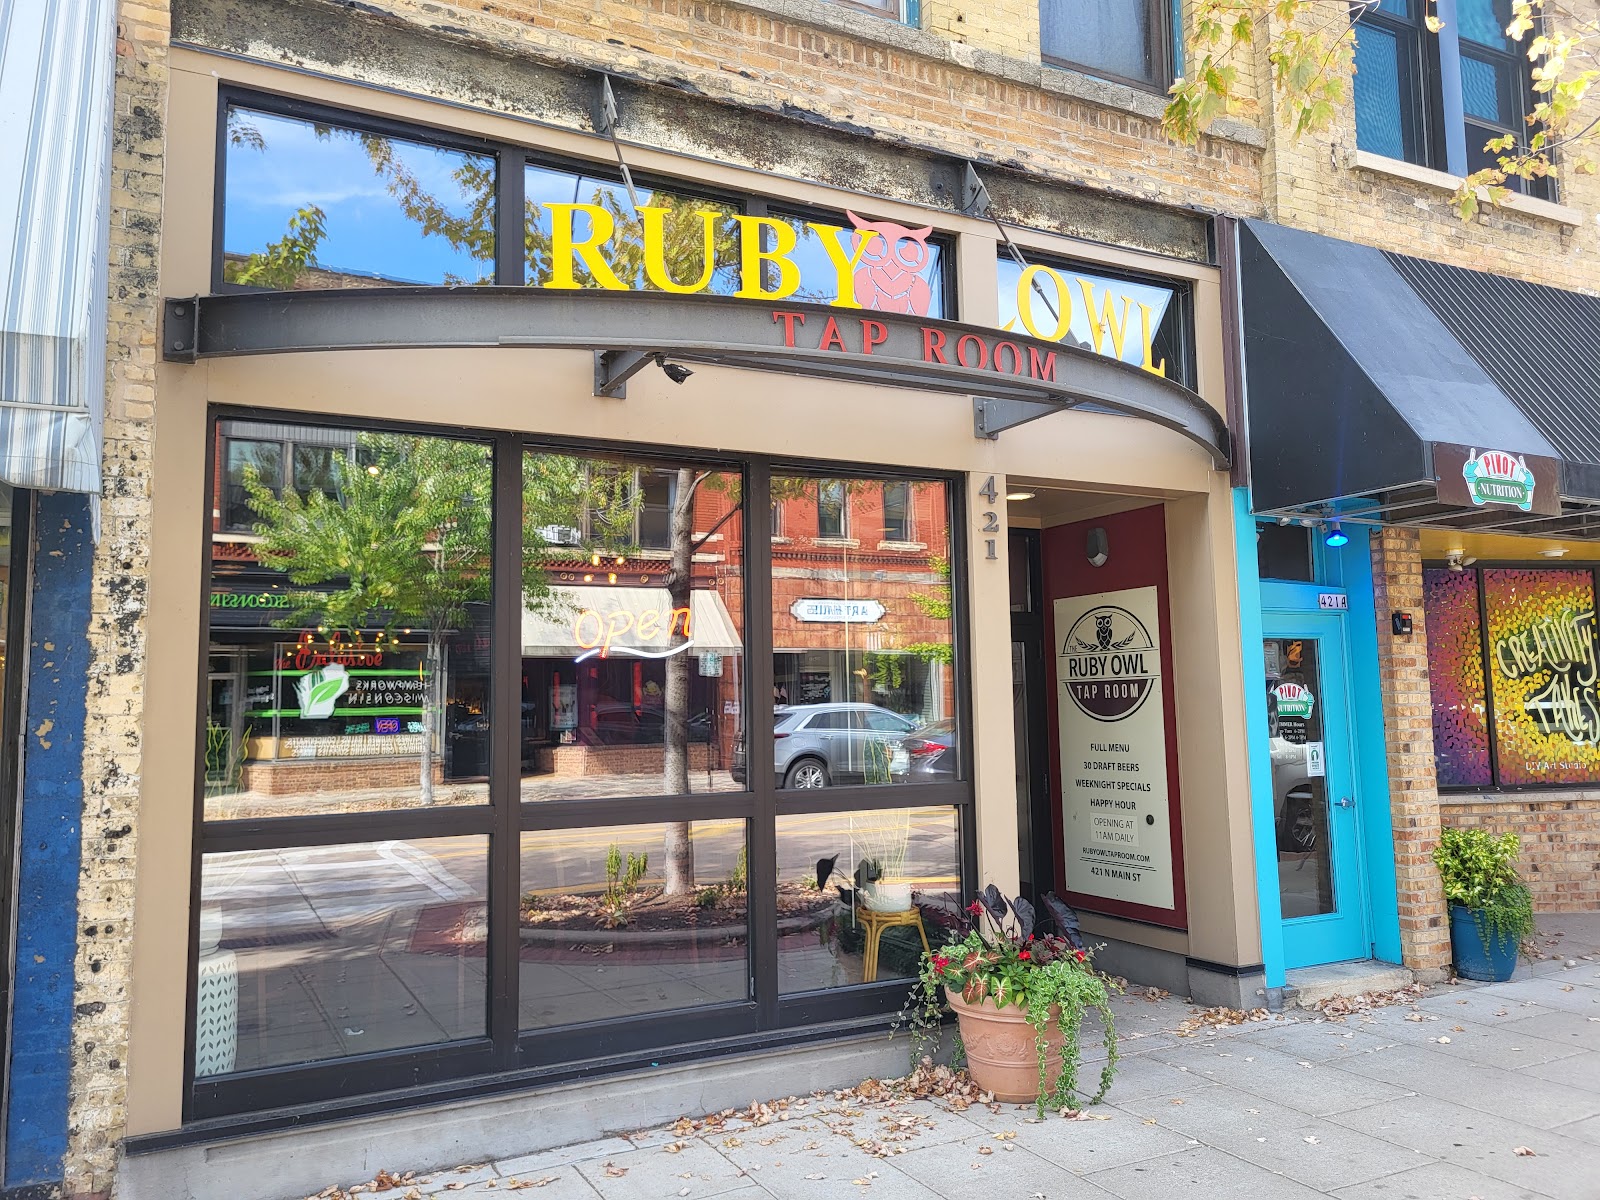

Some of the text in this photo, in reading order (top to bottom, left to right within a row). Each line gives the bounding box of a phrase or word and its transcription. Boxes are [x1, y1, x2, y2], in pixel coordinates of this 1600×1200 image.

[543, 202, 1165, 378] RUBY OWL
[772, 311, 1057, 383] TAP ROOM
[1483, 453, 1516, 478] PIVOT
[1480, 482, 1523, 498] NUTRITION
[979, 475, 999, 560] 421
[1320, 595, 1347, 608] 421A
[1069, 645, 1078, 653] THE
[1496, 608, 1598, 687] CREATIVITY
[1069, 653, 1148, 677] RUBY OWL
[1076, 683, 1139, 699] TAP ROOM
[1279, 685, 1302, 700] PIVOT
[1524, 673, 1600, 743] TAKES
[1090, 743, 1130, 753] FULL MENU
[1083, 761, 1140, 772] 30 DRAFT BEERS
[1525, 760, 1587, 771] DIY Art Studio
[1075, 779, 1151, 792] WEEKNIGHT SPECIALS
[1090, 798, 1137, 810] HAPPY HOUR
[1093, 817, 1134, 829] OPENING AT
[1095, 830, 1135, 843] 11AM DAILY
[1082, 846, 1151, 863] RUBYOWLTAPROOM.COM
[1090, 866, 1142, 882] 421 N MAIN ST
